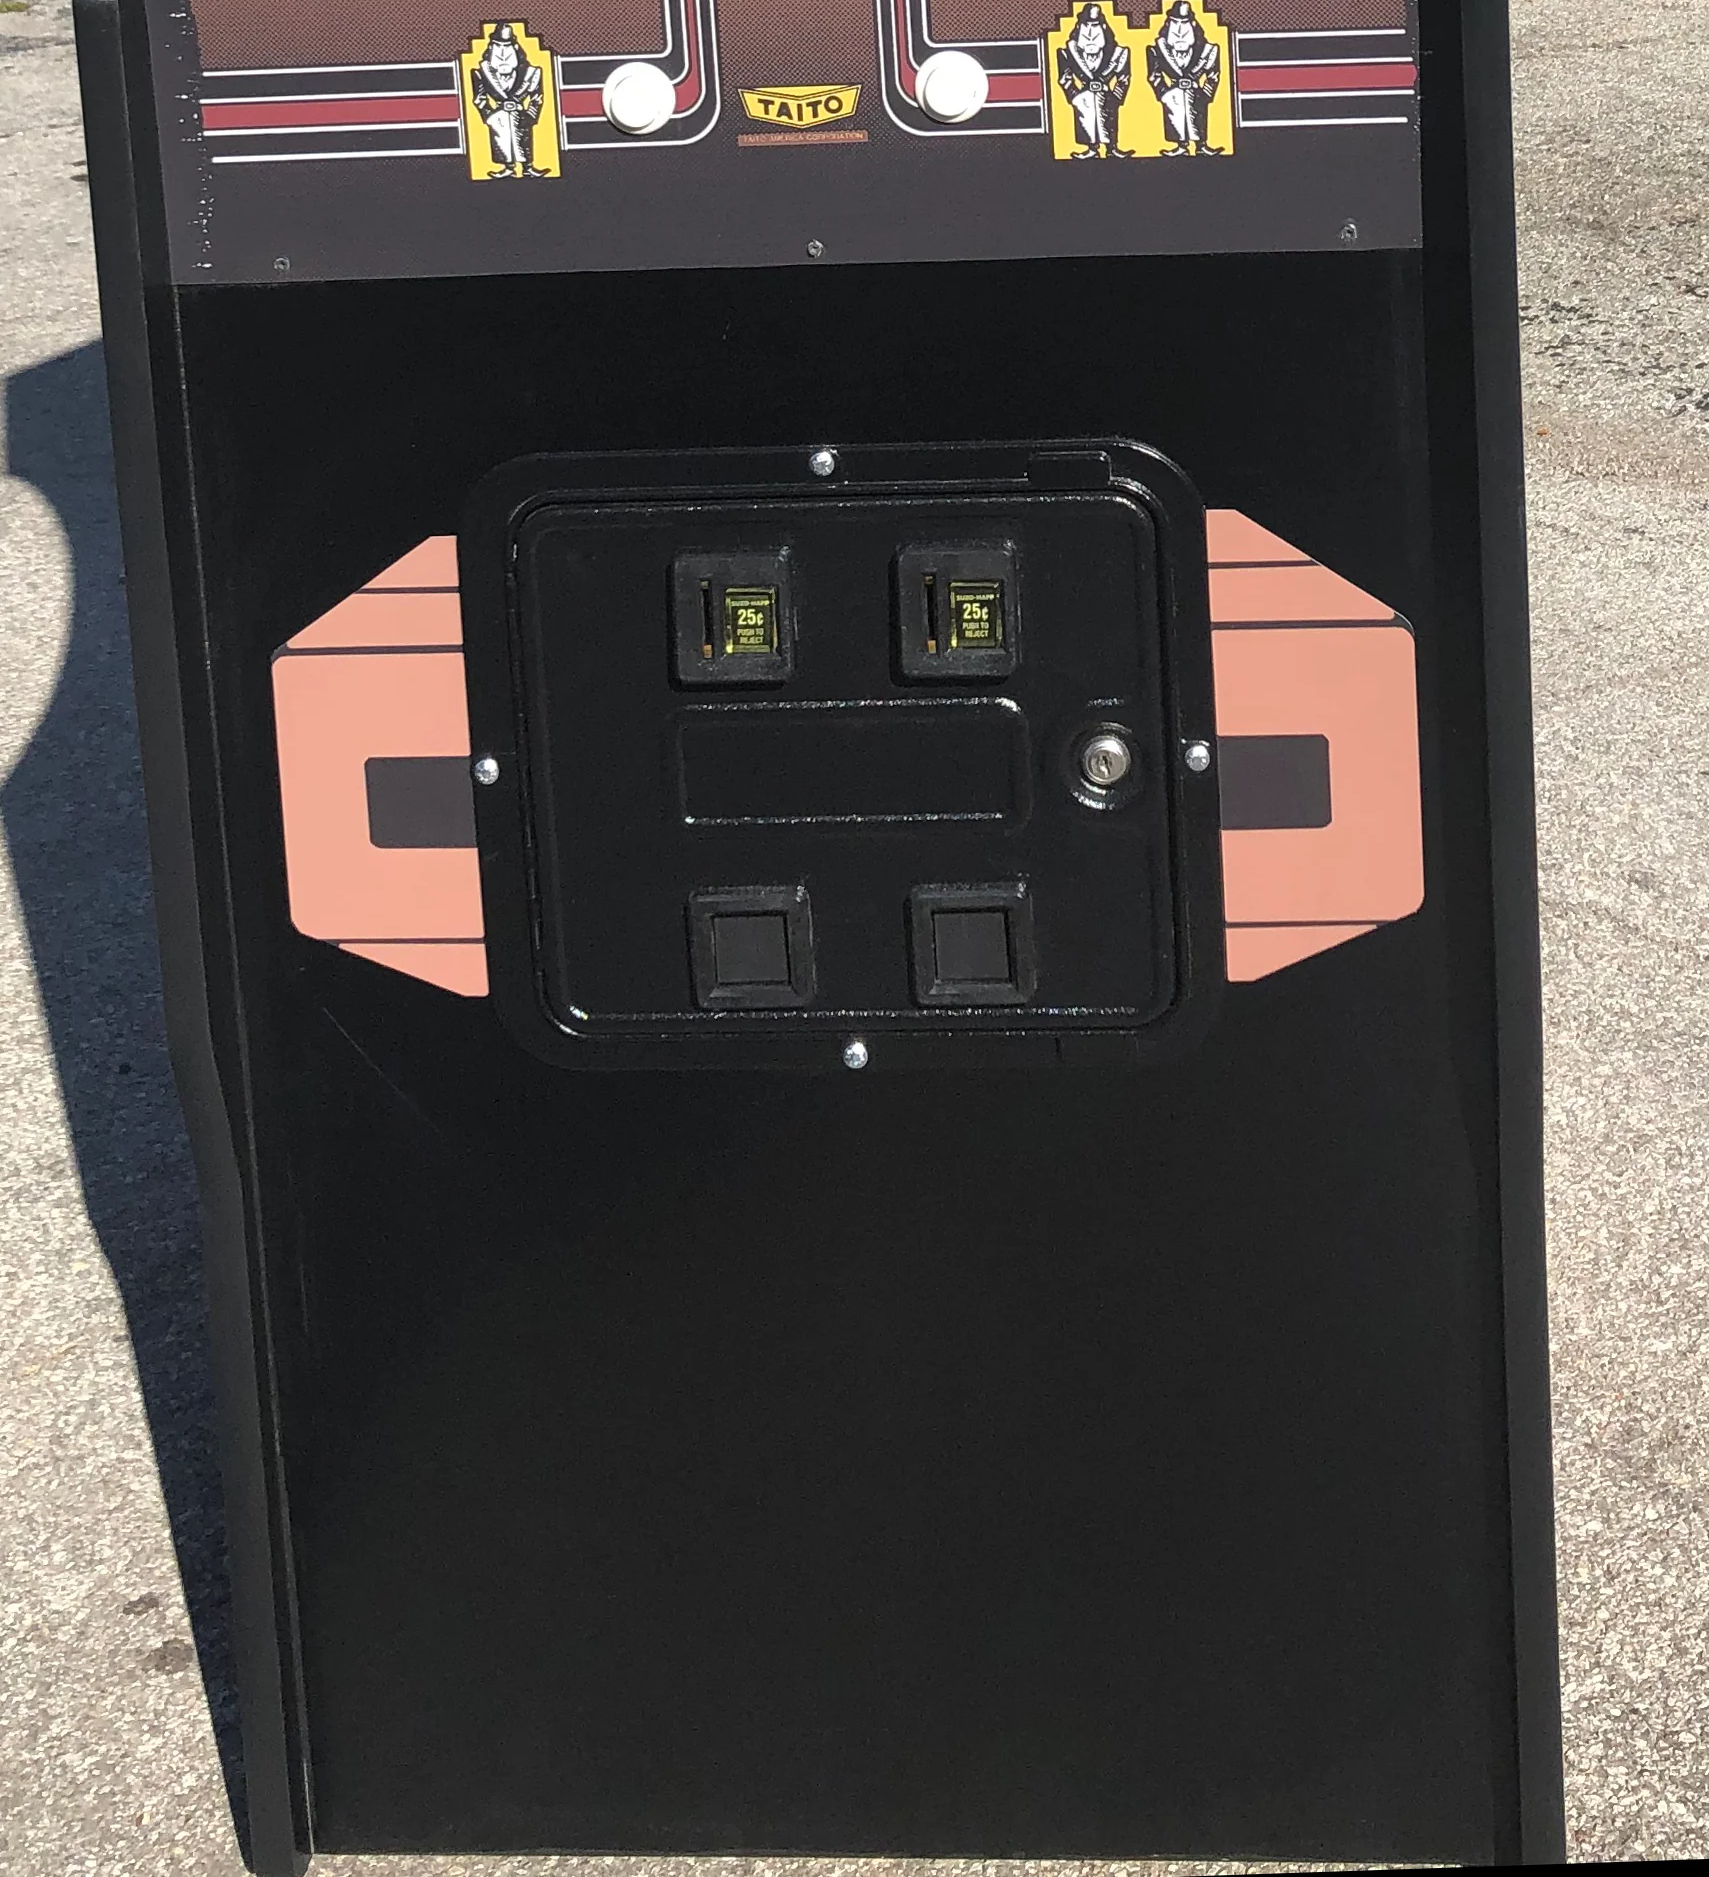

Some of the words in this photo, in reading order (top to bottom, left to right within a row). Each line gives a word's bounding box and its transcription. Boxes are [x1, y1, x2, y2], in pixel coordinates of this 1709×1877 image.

[757, 95, 843, 122] TAITO
[737, 608, 764, 626] 25¢
[962, 603, 989, 621] 25¢
